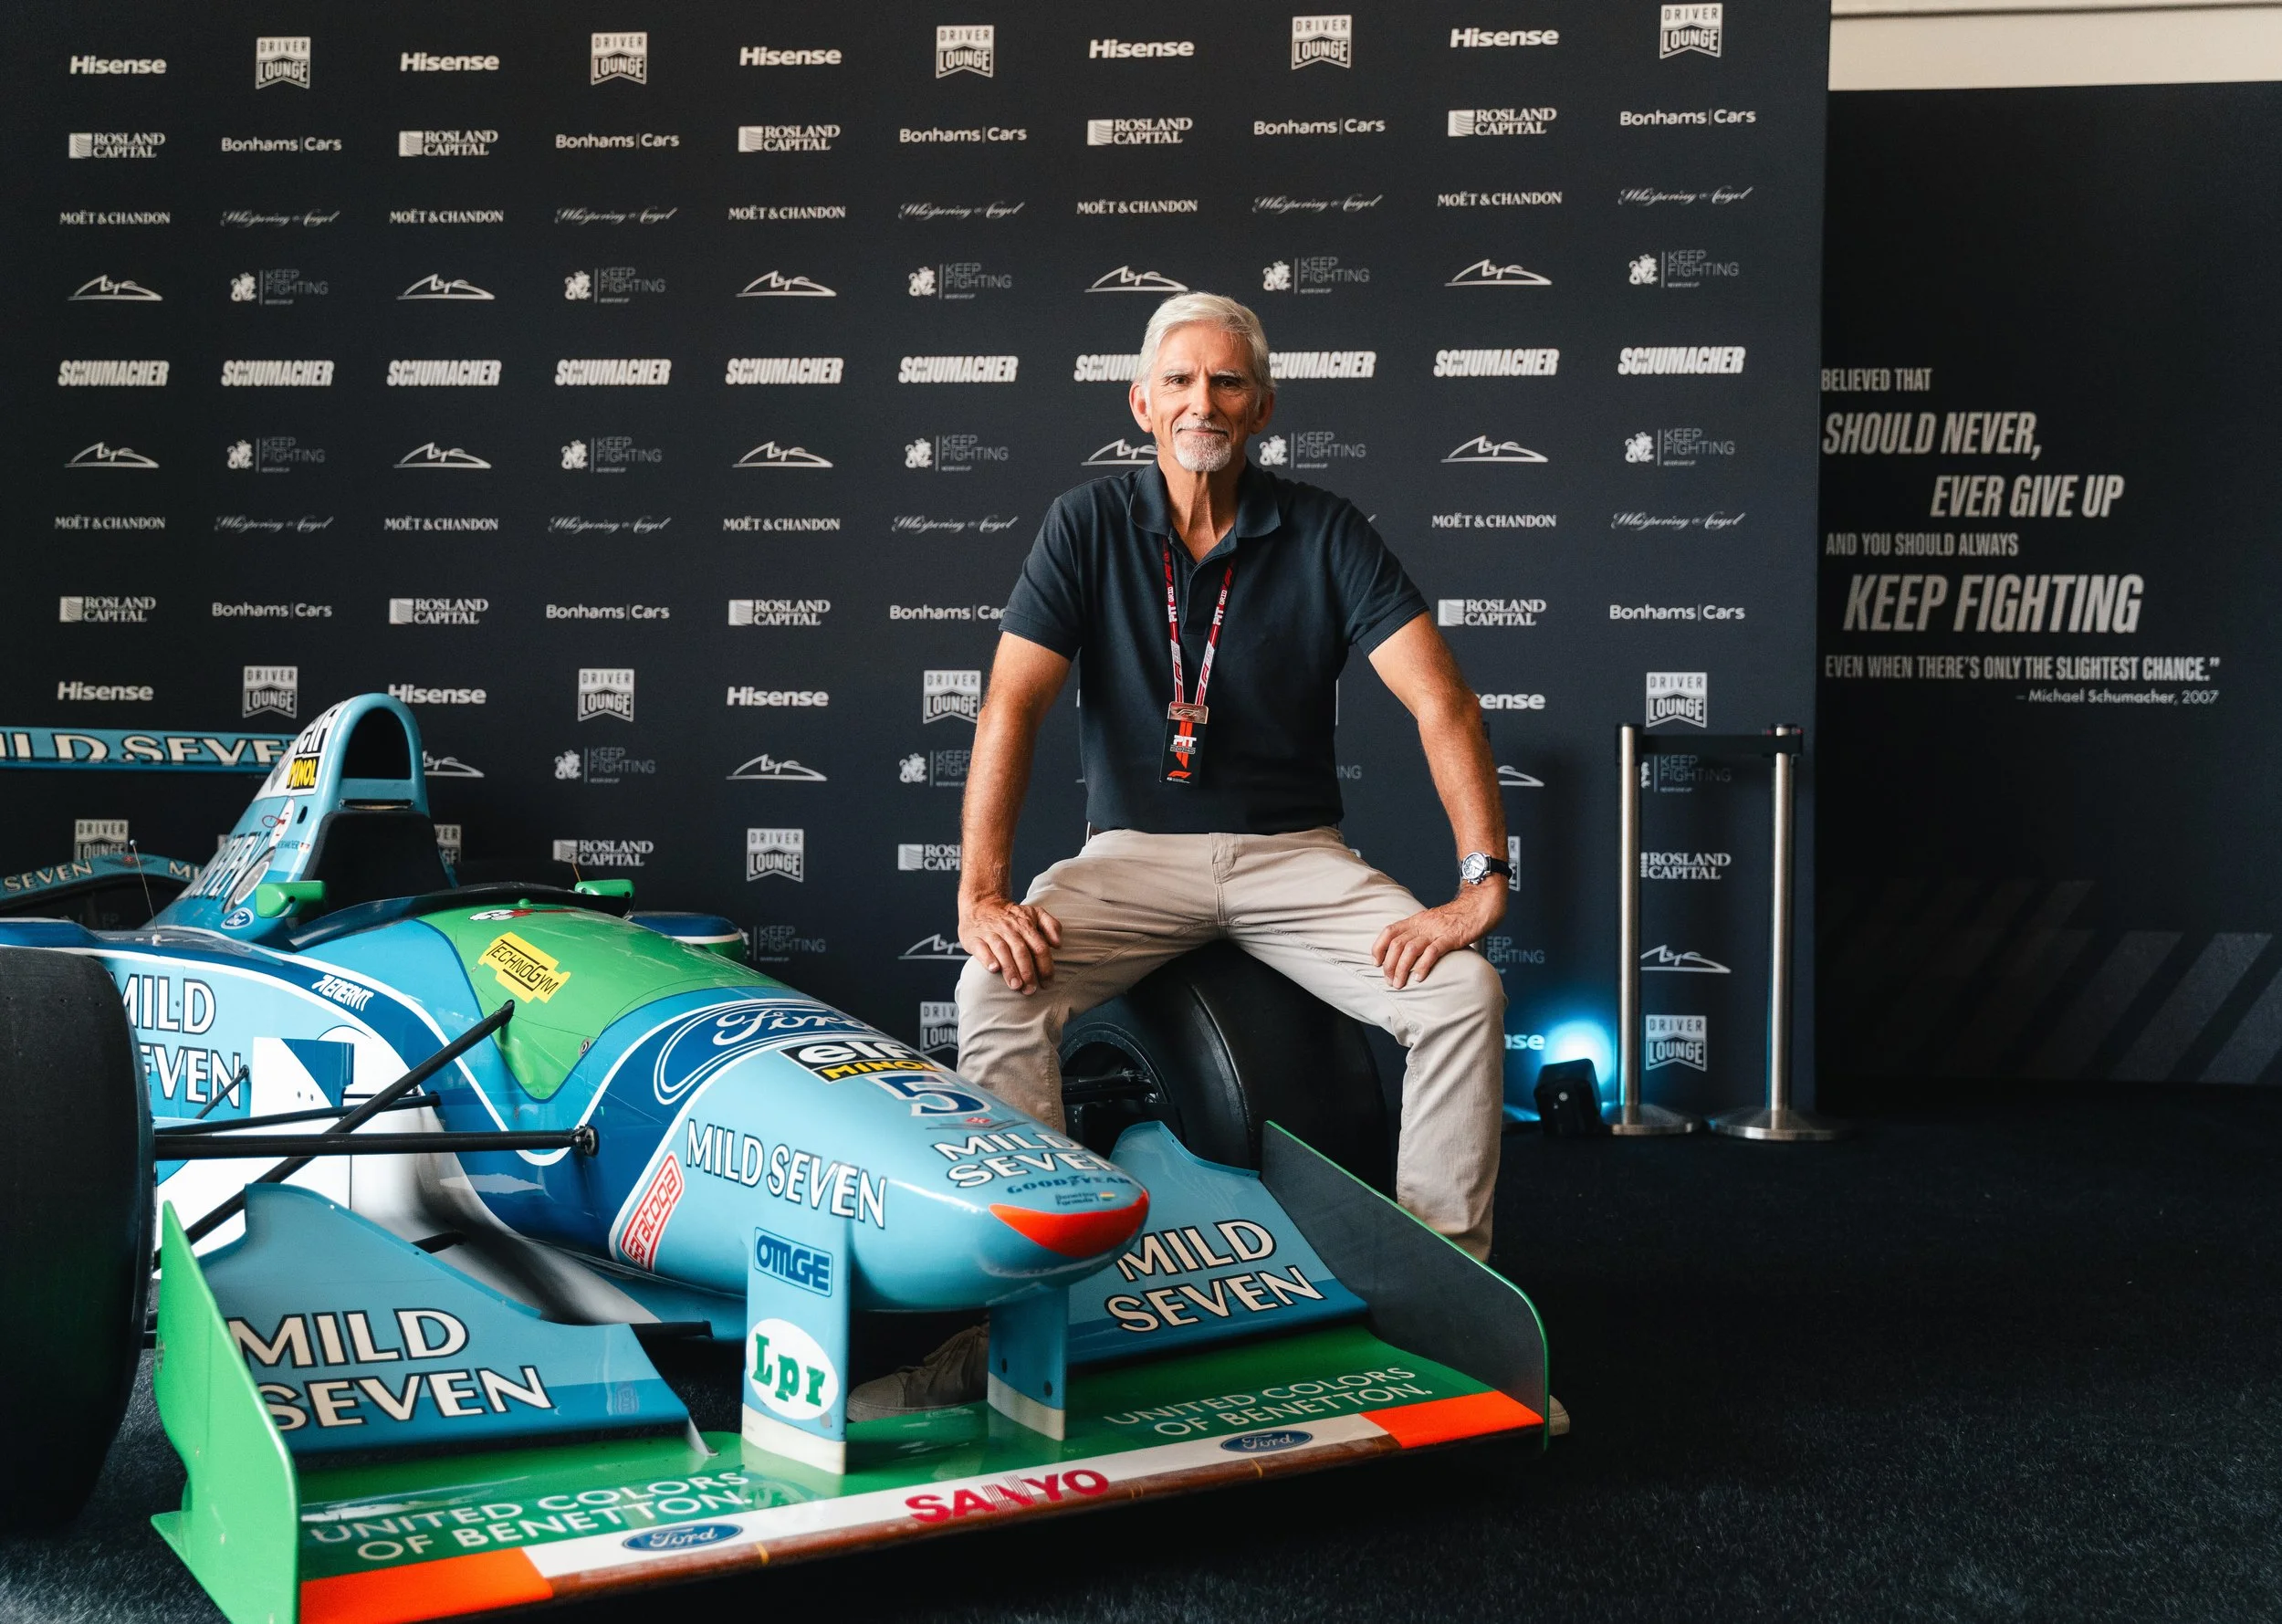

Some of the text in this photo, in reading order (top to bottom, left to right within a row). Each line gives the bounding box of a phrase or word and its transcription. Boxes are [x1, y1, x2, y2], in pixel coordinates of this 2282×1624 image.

[1665, 7, 1719, 20] DRIVER
[940, 28, 990, 41] DRIVER
[1295, 19, 1347, 32] DRIVER
[260, 40, 308, 53] DRIVER
[595, 36, 644, 48] DRIVER
[1450, 27, 1559, 47] Hisense
[1663, 29, 1719, 52] LOUNGE
[739, 47, 842, 66] Hisense
[1089, 39, 1195, 58] Hisense
[1293, 40, 1347, 63] LOUNGE
[69, 55, 167, 74] Hisense
[400, 52, 499, 71] Hisense
[593, 57, 644, 79] LOUNGE
[938, 49, 990, 71] LOUNGE
[258, 61, 308, 82] LOUNGE
[1115, 117, 1193, 132] ROSLAND
[1477, 108, 1557, 123] ROSLAND
[424, 130, 498, 144] ROSLAND
[765, 124, 841, 139] ROSLAND
[1114, 131, 1184, 144] CAPITAL
[1475, 121, 1548, 135] CAPITAL
[94, 132, 165, 146] ROSLAND
[424, 142, 490, 156] CAPITAL
[763, 138, 832, 151] CAPITAL
[93, 145, 157, 159] CAPITAL
[1437, 191, 1563, 206] MOËT & CHANDON
[59, 210, 170, 225] MOËT & CHANDON
[728, 204, 845, 220] MOËT & CHANDON
[1668, 249, 1706, 263] KEEP
[265, 268, 299, 281] KEEP
[1667, 262, 1740, 278] FIGHTING
[265, 280, 329, 295] FIGHTING
[898, 356, 1019, 383] SCHUMACHER
[1433, 349, 1560, 379] SCHUMACHER
[1617, 346, 1746, 375] SCHUMACHER
[58, 360, 170, 386] SCHUMACHER
[221, 360, 334, 386] SCHUMACHER
[386, 360, 502, 386] SCHUMACHER
[554, 359, 672, 386] SCHUMACHER
[725, 357, 843, 385] SCHUMACHER
[1820, 368, 1931, 392] BELIEVED THAT
[597, 436, 632, 449] KEEP
[1822, 412, 2042, 460] SHOULD NEVER,
[597, 448, 663, 463] FIGHTING
[1930, 475, 2125, 518] EVER GIVE UP
[384, 516, 498, 530] MOËT & CHANDON
[1826, 532, 2019, 556] AND YOU SHOULD ALWAYS
[85, 596, 156, 610] ROSLAND
[1467, 599, 1546, 613] ROSLAND
[1842, 574, 2145, 634] KEEP FIGHTING
[84, 609, 148, 623] CAPITAL
[1465, 612, 1537, 626] CAPITAL
[246, 669, 294, 682] DRIVER
[1826, 655, 1864, 679] EVEN
[1867, 655, 1913, 679] WHEN
[1916, 655, 1980, 680] THERE’S
[1983, 655, 2022, 680] ONLY
[2022, 655, 2053, 680] THE
[2055, 655, 2140, 681] SLIGHTEST
[582, 672, 631, 685] DRIVER
[1650, 676, 1703, 689] DRIVER
[58, 681, 153, 701] Hisense
[245, 690, 294, 711] LOUNGE
[388, 684, 487, 705] Hisense
[727, 686, 829, 707] Hisense
[2027, 687, 2220, 706] Michael Schumacher, 2007
[581, 693, 631, 715] LOUNGE
[1649, 697, 1703, 720] LOUNGE
[1173, 734, 1197, 748] PIT
[751, 833, 801, 845] DRIVER
[749, 854, 801, 875] LOUNGE
[1651, 852, 1732, 866] ROSLAND
[3, 859, 93, 893] SEVEN
[1649, 865, 1722, 880] CAPITAL
[1650, 1019, 1702, 1032] DRIVER
[798, 1041, 913, 1063] elf
[1649, 1041, 1702, 1064] LOUNGE
[865, 1073, 989, 1117] 5
[933, 1132, 1085, 1162] MILD
[686, 1118, 887, 1230] MILD SEVEN
[1116, 1219, 1277, 1282] MILD
[1104, 1264, 1325, 1332] SEVEN
[226, 1307, 470, 1369] MILD
[256, 1365, 558, 1431] SEVEN
[1103, 1367, 1416, 1425] UNITED COLORS
[1153, 1383, 1433, 1436] OF BENETTON.
[1241, 1430, 1296, 1451] Ford
[905, 1468, 1110, 1524] SANYO
[309, 1472, 749, 1543] UNITED COLORS
[650, 1525, 717, 1550] Ford
[357, 1534, 434, 1562] OF
